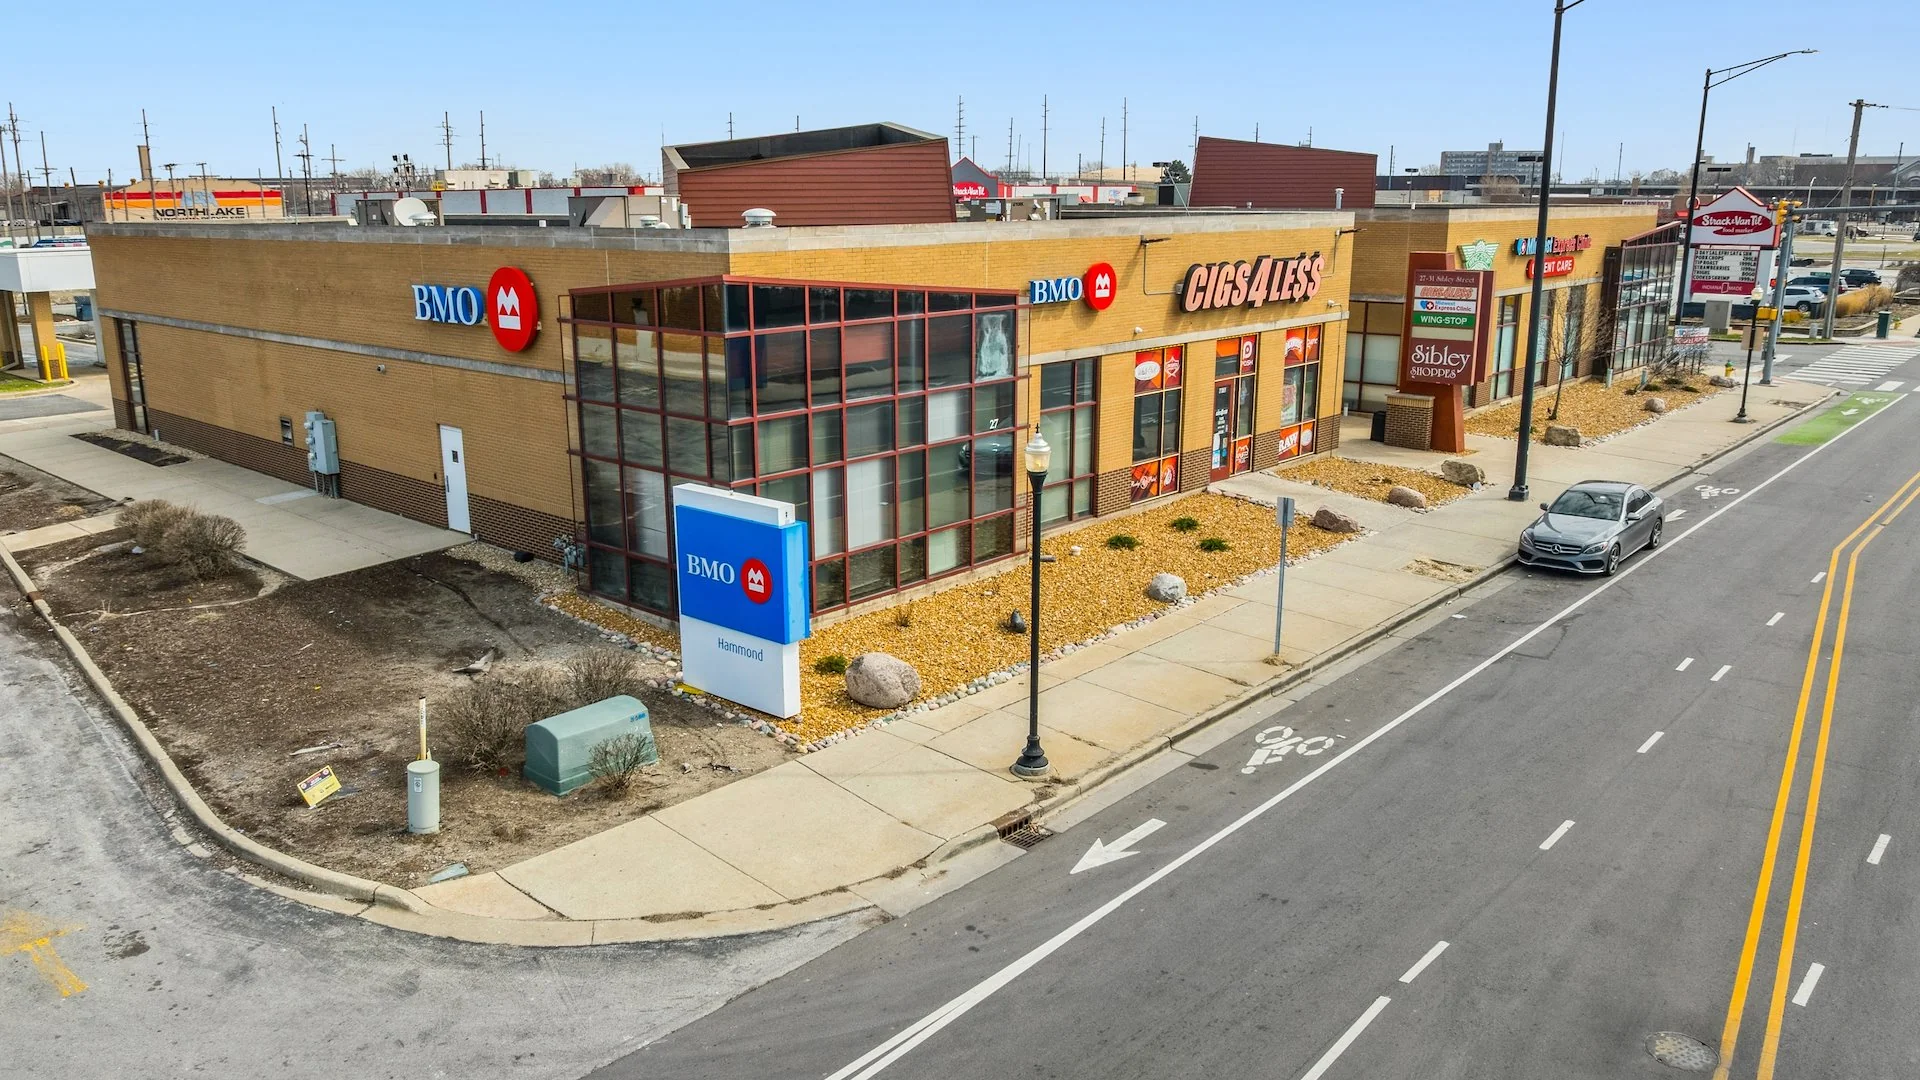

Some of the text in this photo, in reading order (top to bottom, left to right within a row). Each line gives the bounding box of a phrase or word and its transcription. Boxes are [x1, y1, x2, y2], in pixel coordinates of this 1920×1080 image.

[1701, 215, 1731, 226] Strack
[1734, 216, 1750, 226] Van
[1750, 215, 1763, 226] Til
[1556, 260, 1573, 272] CARE
[1435, 275, 1454, 284] Sibley
[1455, 276, 1475, 284] Street
[1031, 278, 1083, 304] BMO
[411, 284, 482, 326] BMO
[1411, 344, 1472, 373] Sibley
[1410, 366, 1457, 379] SHOPPES
[989, 418, 999, 430] 27
[1279, 431, 1299, 452] RAW
[686, 553, 736, 585] BMO
[718, 637, 764, 662] Hammond
